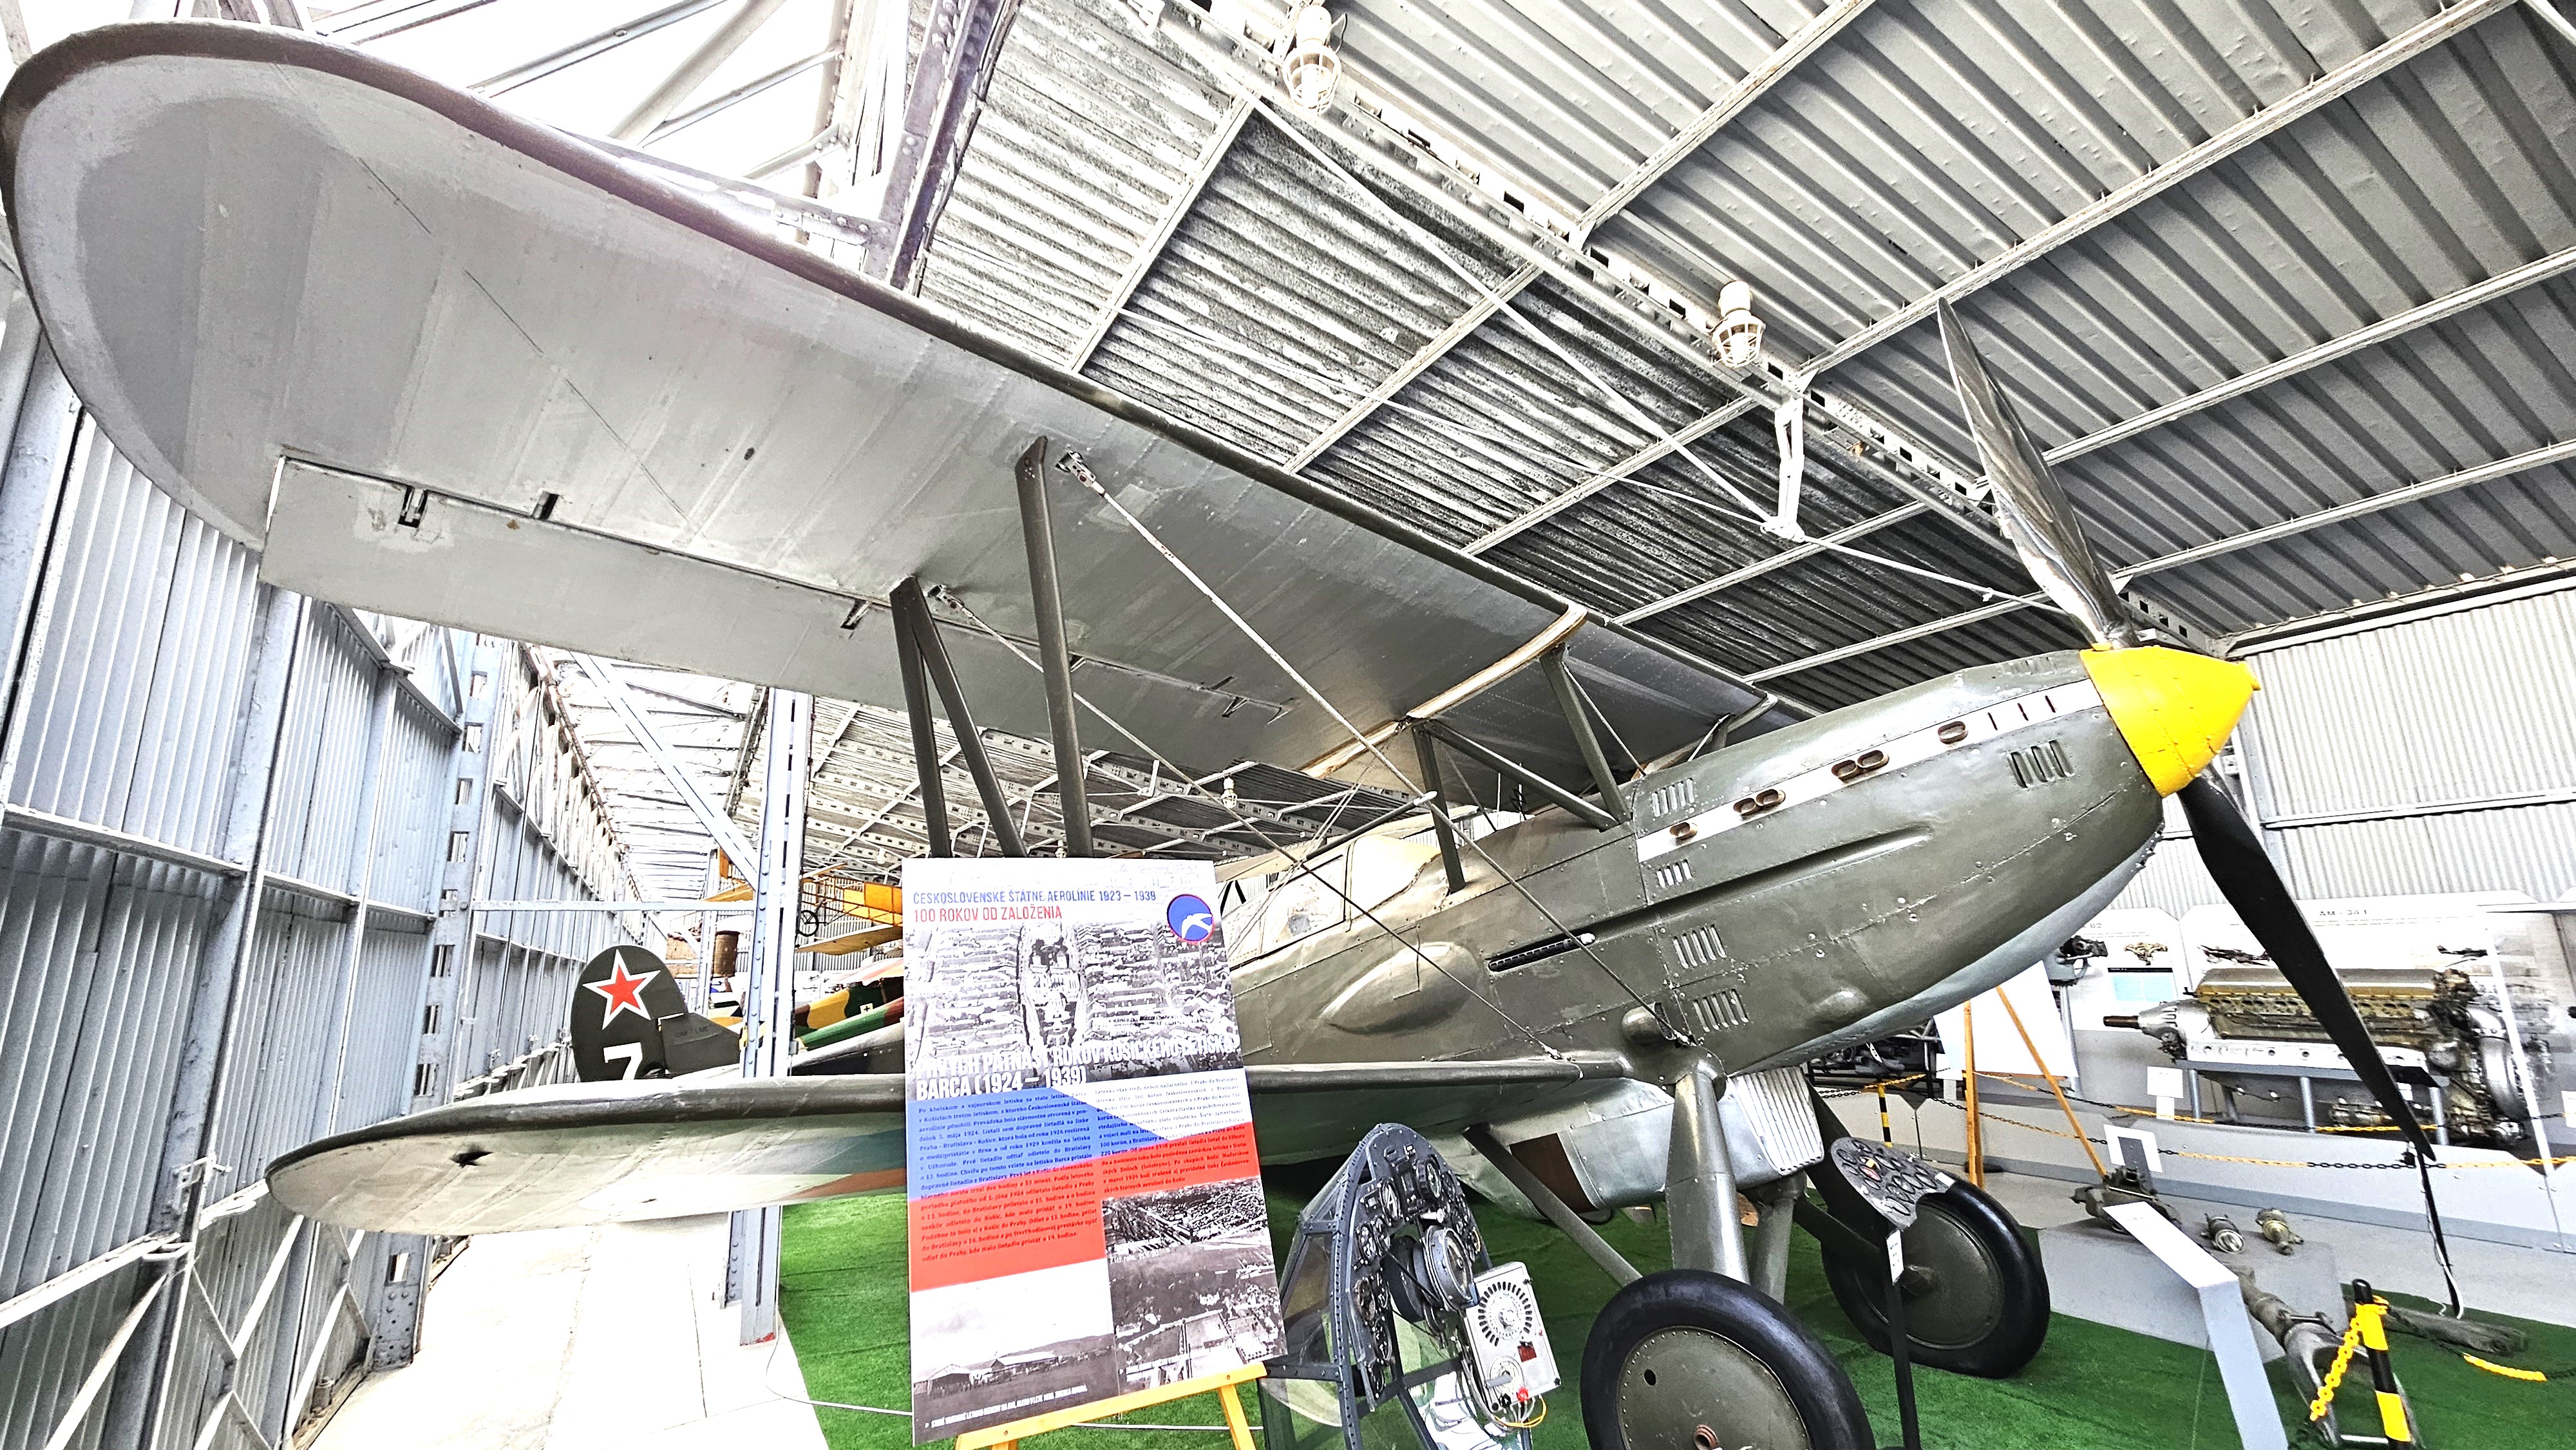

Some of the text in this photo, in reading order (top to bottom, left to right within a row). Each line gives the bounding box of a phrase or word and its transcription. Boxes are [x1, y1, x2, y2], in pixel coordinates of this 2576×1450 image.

[914, 889, 1005, 904] ČESKOSLOVENSKÉ
[1009, 889, 1045, 902] ŠTÁTNE
[1048, 888, 1095, 901] AEROLÍNIE
[1099, 890, 1121, 901] 1923
[1134, 890, 1156, 901] 1939
[914, 904, 1062, 922] 100 ROKOV OD ZALOŽENIA
[603, 1042, 643, 1080] 7
[916, 1052, 983, 1080] PRVÝCH
[1049, 1039, 1101, 1067] ROKOV
[916, 1075, 972, 1101] BARCA
[975, 1071, 1023, 1095] (1924
[1044, 1065, 1086, 1088] 1939)
[967, 1100, 1001, 1109] vajnorskom
[1028, 1100, 1070, 1111] Československé
[973, 1118, 1002, 1126] Prevádzka
[1016, 1122, 1042, 1131] dopravné
[943, 1140, 972, 1149] Bratislava
[1065, 1144, 1091, 1153] Bratislavy
[1070, 1153, 1092, 1162] pristálo
[920, 1182, 949, 1192] dopravné
[950, 1178, 972, 1187] lietadlo
